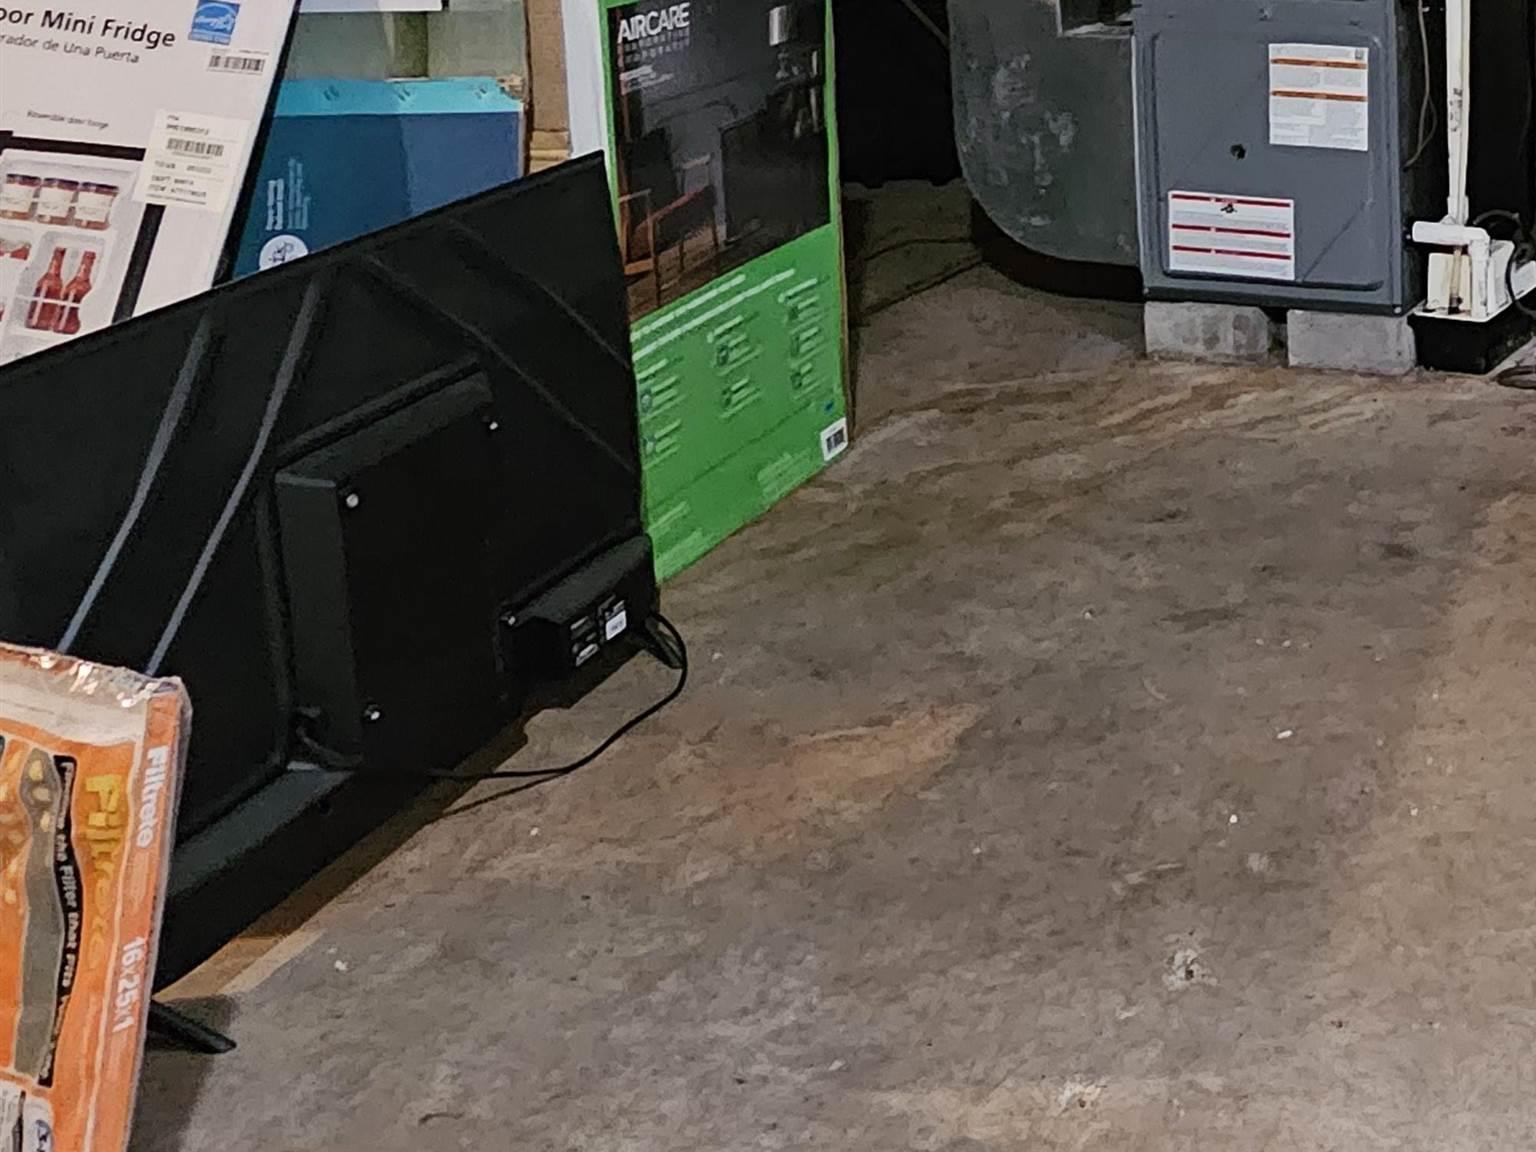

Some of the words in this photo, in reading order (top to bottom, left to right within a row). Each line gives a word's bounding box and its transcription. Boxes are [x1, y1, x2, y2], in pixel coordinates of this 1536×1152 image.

[41, 10, 96, 35] Mini
[101, 19, 176, 50] Fridge
[617, 1, 691, 44] AIRCARE
[42, 38, 61, 53] de
[136, 745, 169, 848] Filtrete
[59, 865, 78, 908] Filter
[66, 912, 80, 949] that
[111, 936, 147, 1032] 16x25x1
